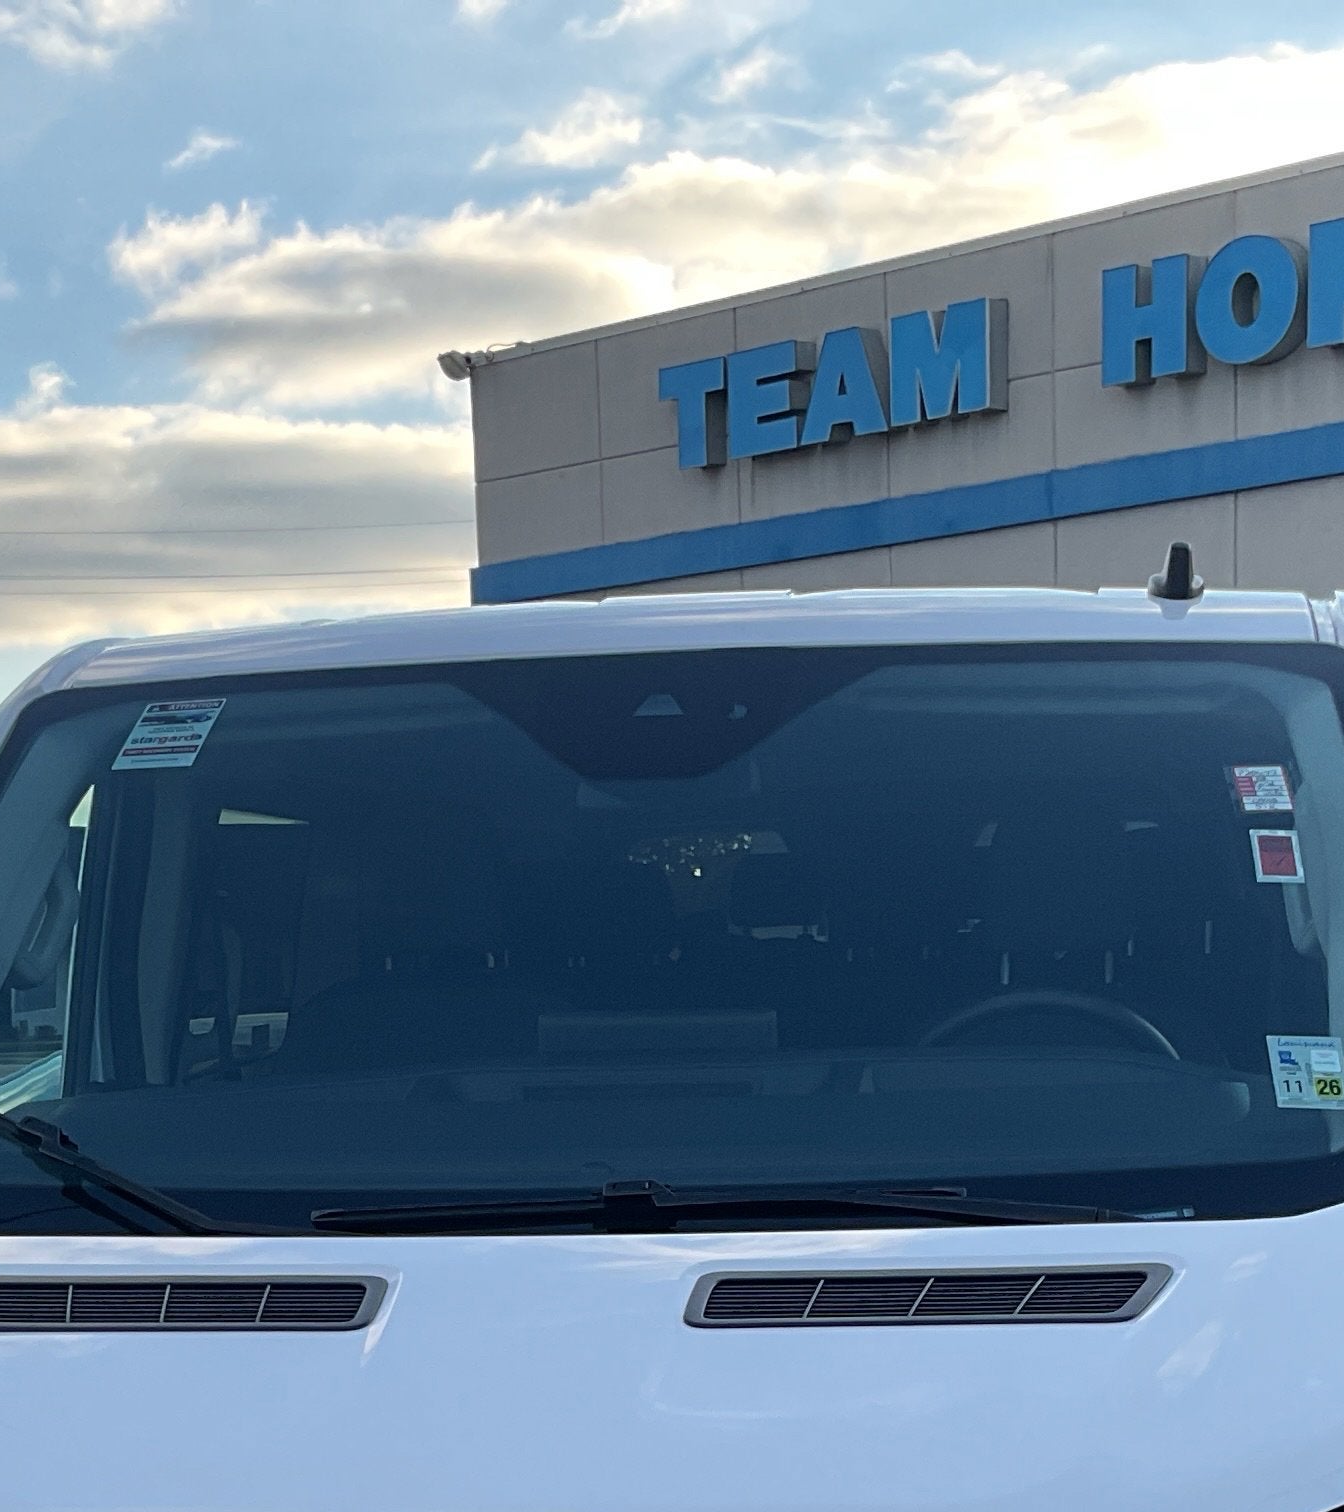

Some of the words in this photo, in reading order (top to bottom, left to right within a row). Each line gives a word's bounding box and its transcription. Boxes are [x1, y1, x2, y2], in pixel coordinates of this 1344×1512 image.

[659, 298, 1004, 469] TEAM
[1282, 1079, 1303, 1093] 11
[1316, 1079, 1342, 1096] 26
